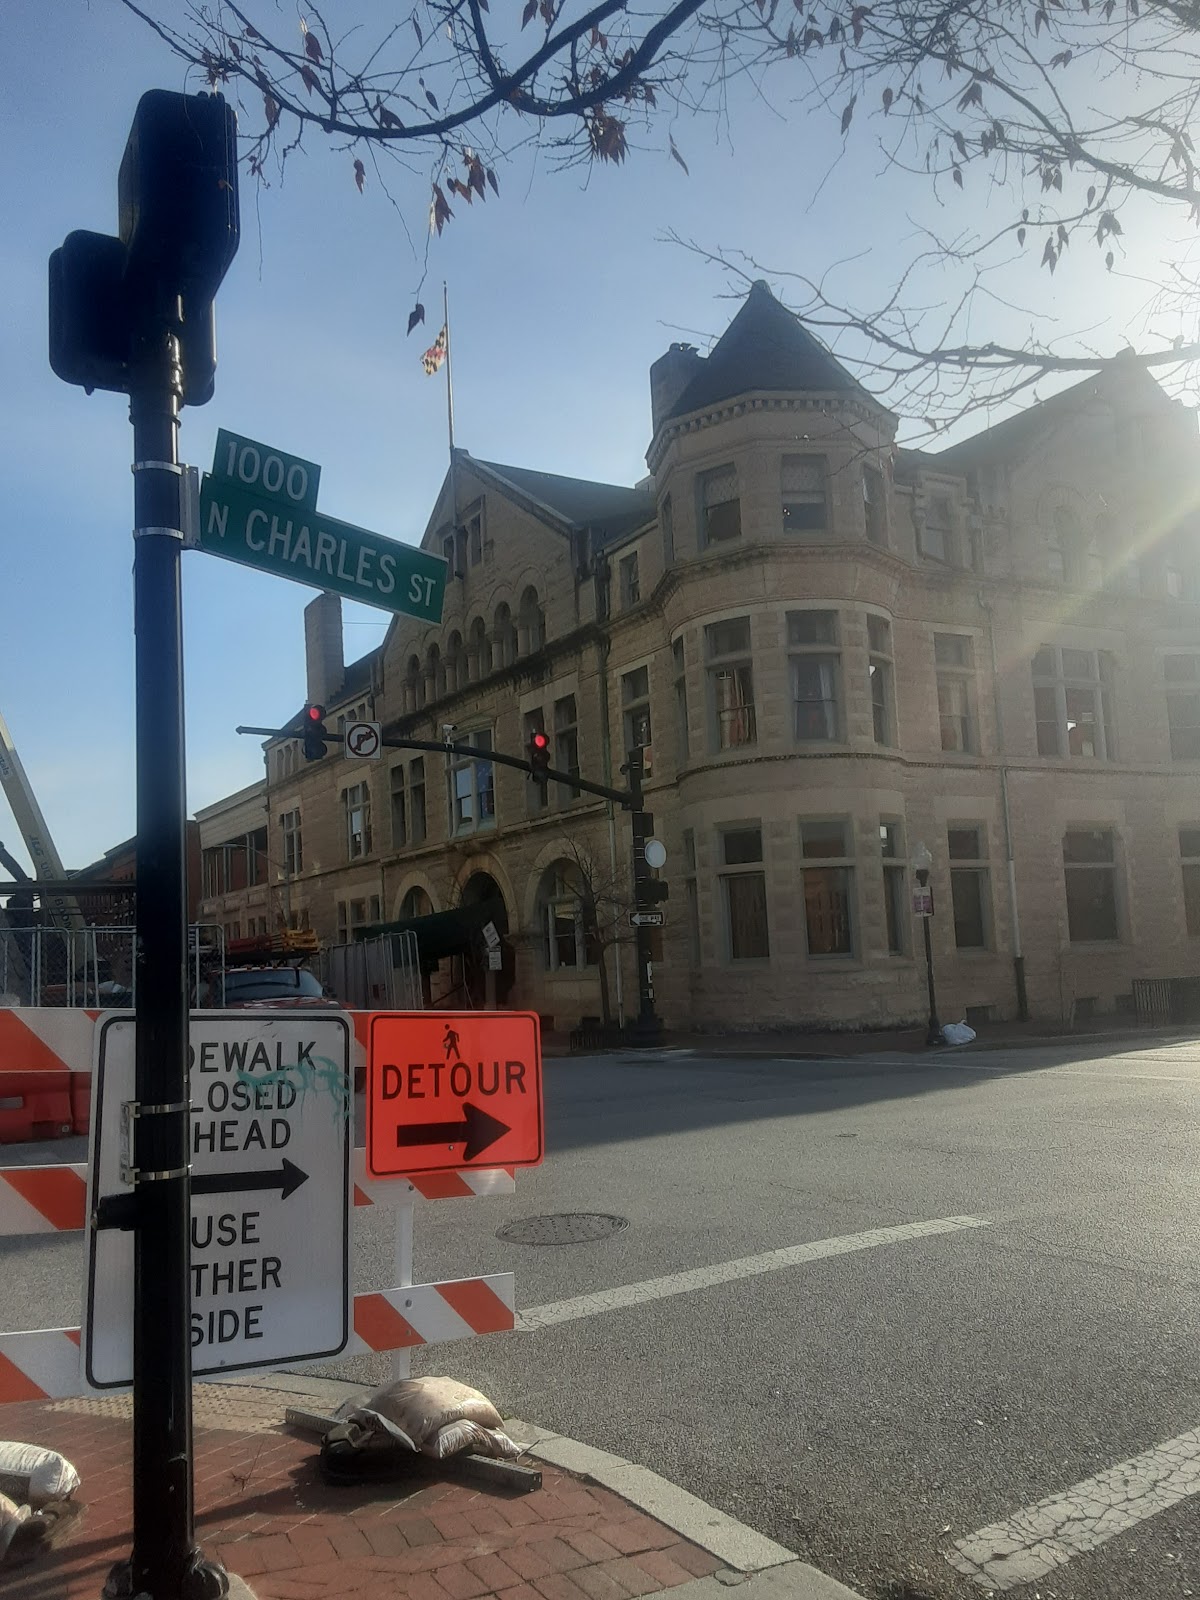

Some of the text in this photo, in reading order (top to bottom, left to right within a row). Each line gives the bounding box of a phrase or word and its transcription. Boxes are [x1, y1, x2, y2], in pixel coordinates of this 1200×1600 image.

[225, 441, 308, 501] 1000
[207, 501, 437, 607] N CHARLES ST
[189, 1040, 317, 1074] EWALK
[190, 1079, 297, 1113] OSED
[382, 1060, 527, 1100] DETOUR
[193, 1118, 291, 1154] HEAD
[191, 1211, 260, 1249] USE
[190, 1256, 282, 1298] THER
[190, 1304, 264, 1348] SIDE
